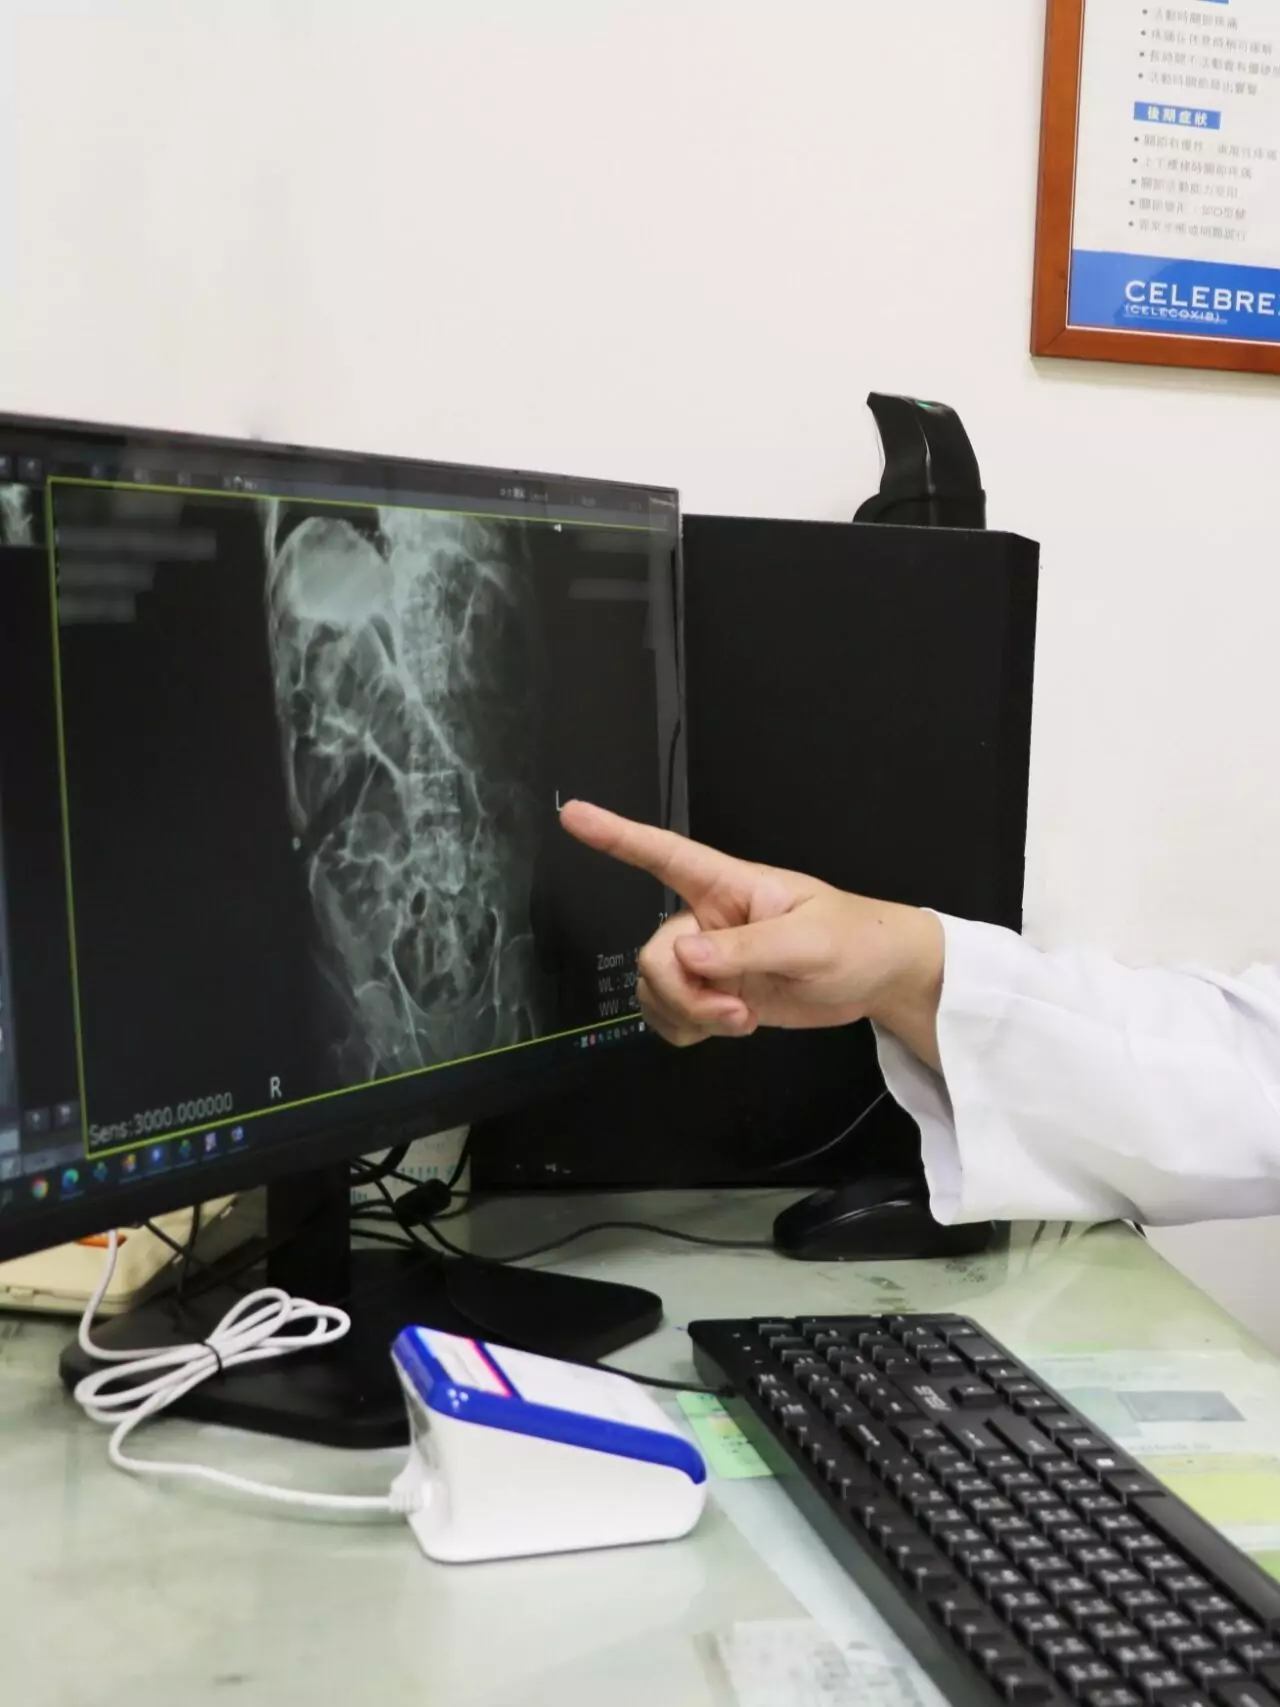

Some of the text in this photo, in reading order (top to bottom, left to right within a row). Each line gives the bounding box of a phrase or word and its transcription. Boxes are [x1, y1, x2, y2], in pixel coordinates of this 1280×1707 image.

[1147, 105, 1208, 127] 後期症狀
[596, 952, 624, 971] Zoom
[269, 1076, 283, 1100] R
